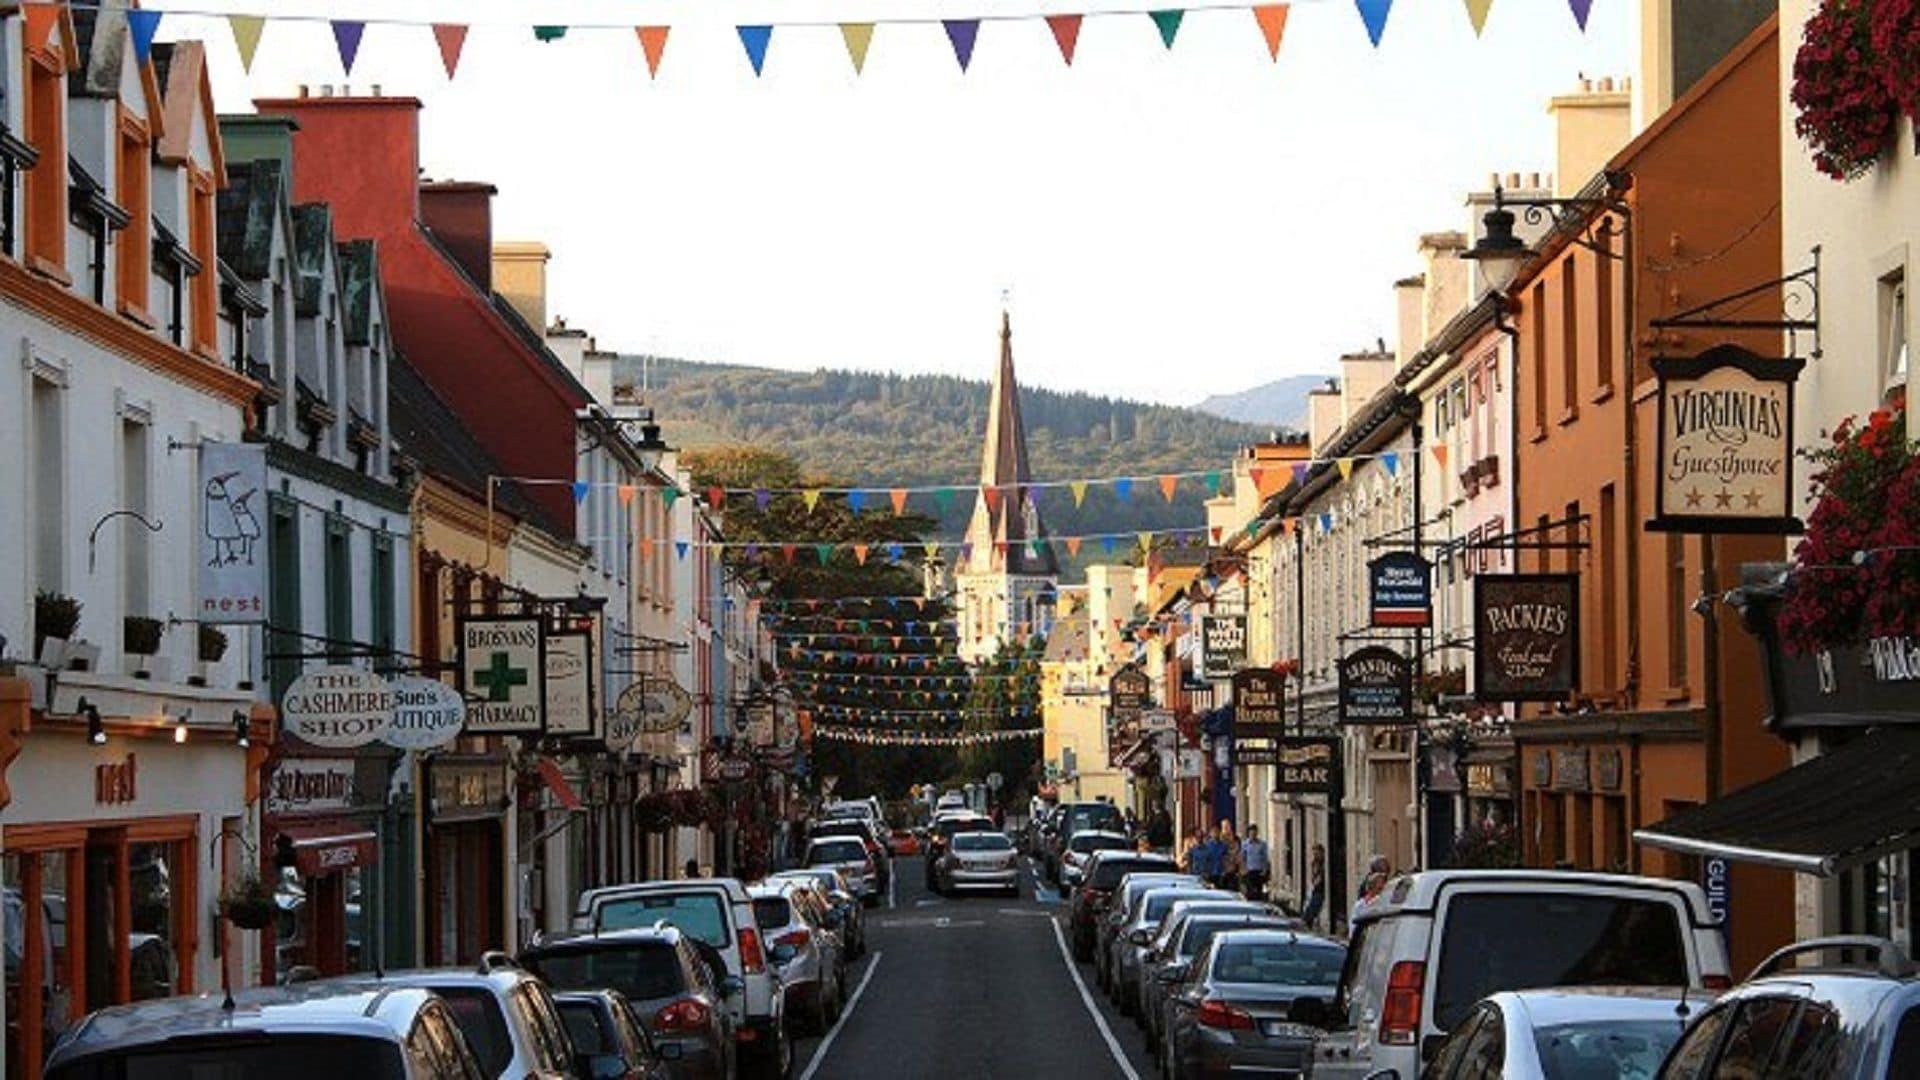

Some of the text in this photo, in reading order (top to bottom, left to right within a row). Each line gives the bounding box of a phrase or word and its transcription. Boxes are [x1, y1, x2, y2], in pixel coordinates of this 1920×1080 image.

[1672, 387, 1782, 444] VIRGINIA'S
[1668, 446, 1781, 483] Guesthouse
[204, 595, 262, 612] nest
[1486, 604, 1568, 635] PACKIE'S
[467, 624, 537, 649] BROSNAN'S
[314, 675, 361, 688] THE
[286, 692, 390, 714] CASHMERE
[393, 686, 437, 706] Sue's
[389, 708, 461, 730] UTIQUE
[467, 703, 538, 723] PHARMACY
[300, 717, 382, 737] SHOP
[1283, 766, 1329, 783] BAR
[1707, 860, 1727, 923] GUILD
